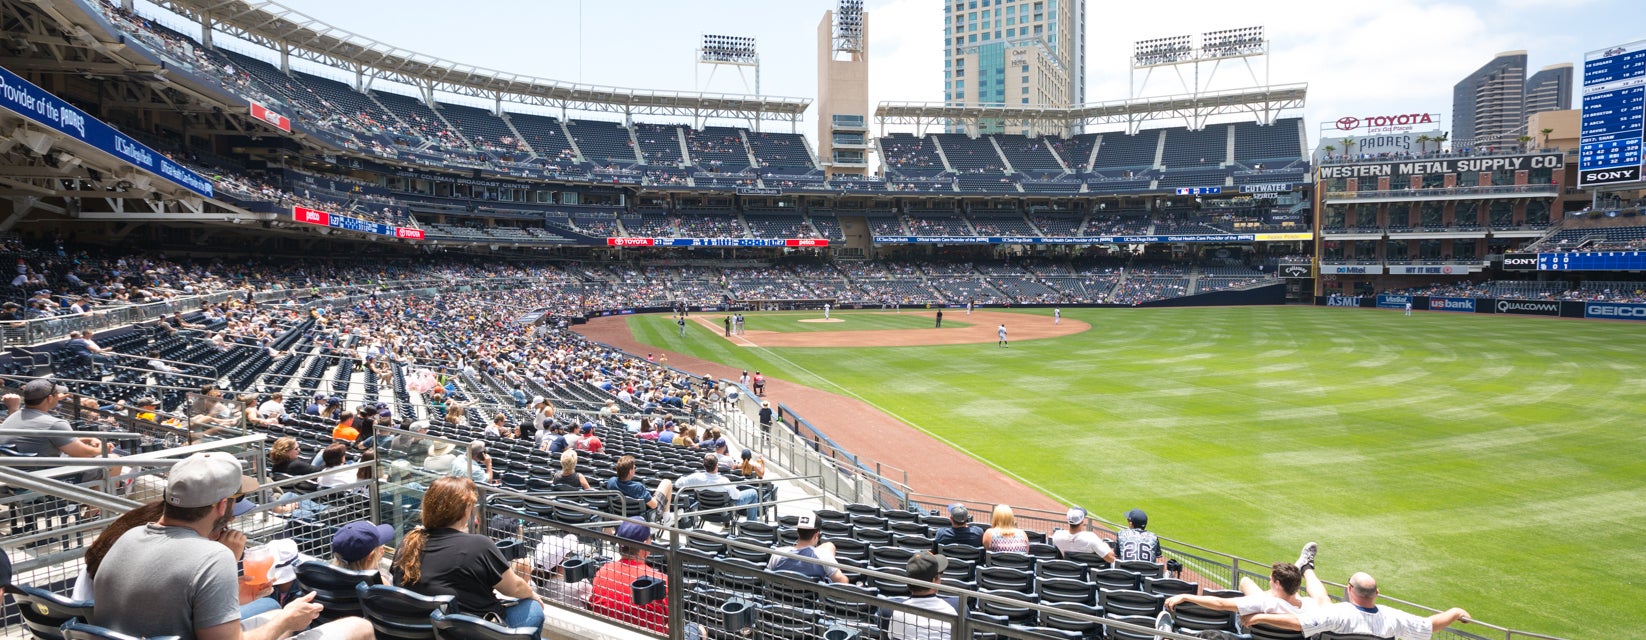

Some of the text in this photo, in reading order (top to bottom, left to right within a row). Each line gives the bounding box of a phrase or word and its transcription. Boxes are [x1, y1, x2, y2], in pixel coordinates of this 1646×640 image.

[0, 76, 85, 138] Provider of the PADRES
[1365, 113, 1432, 126] TOYOTA
[1360, 136, 1410, 152] PADRES
[1320, 156, 1561, 178] WESTERN METAL SUPPLY CO.
[1587, 170, 1634, 181] SONY
[457, 178, 500, 187] BROADCAST
[1245, 184, 1286, 192] CUTWATER
[306, 211, 319, 221] petco
[330, 216, 339, 226] 1:27
[1285, 266, 1308, 274] Callaway
[1328, 297, 1359, 306] ASML
[1498, 301, 1557, 312] QUALCOMM
[1588, 306, 1646, 316] GEICO
[1124, 542, 1152, 562] 26
